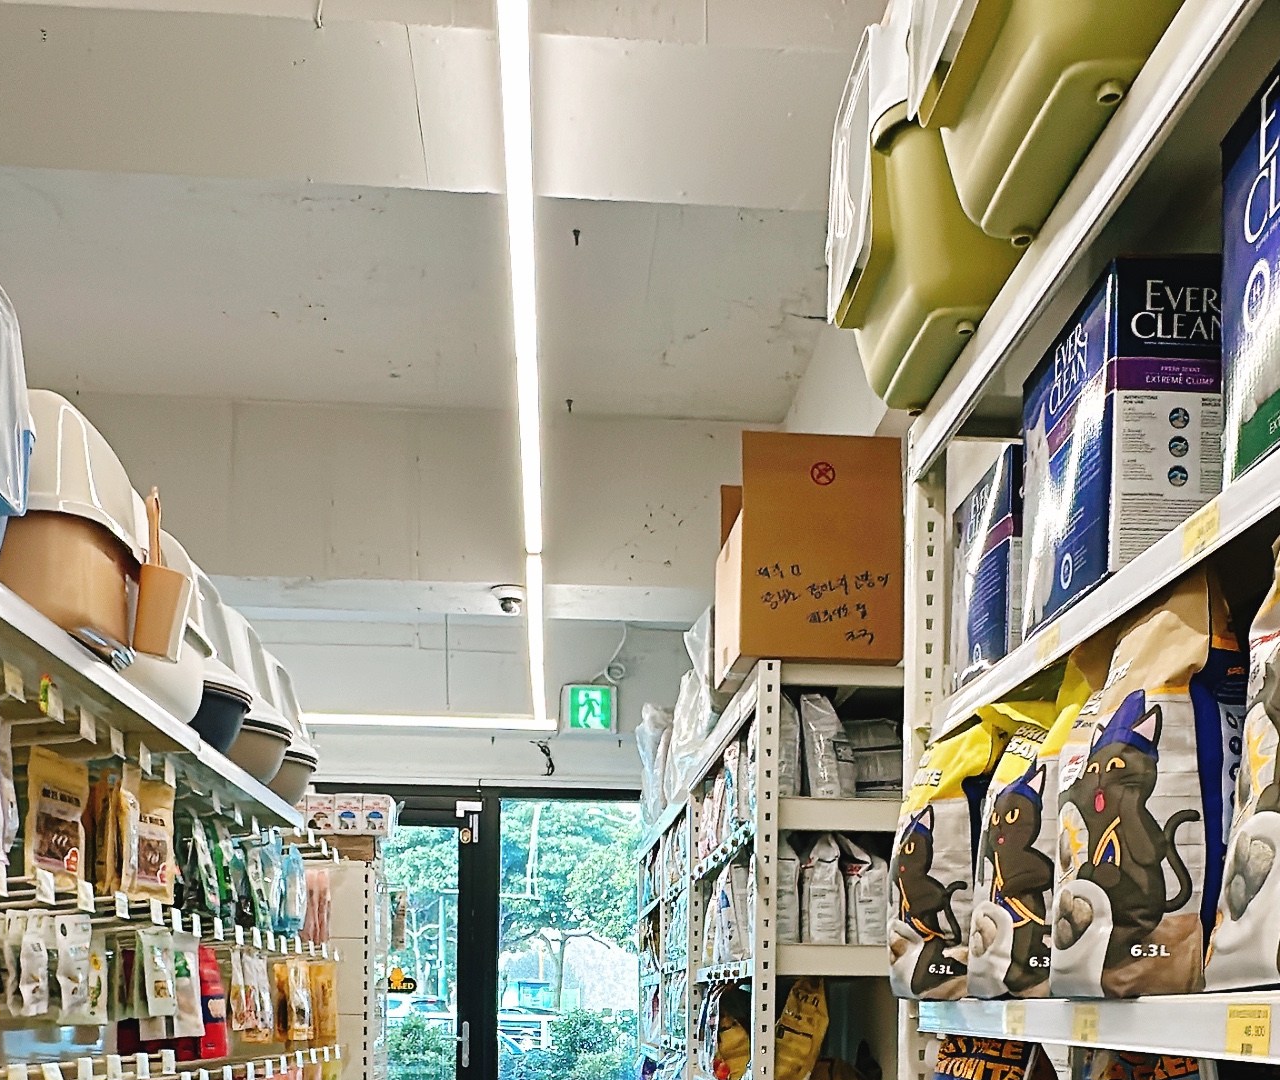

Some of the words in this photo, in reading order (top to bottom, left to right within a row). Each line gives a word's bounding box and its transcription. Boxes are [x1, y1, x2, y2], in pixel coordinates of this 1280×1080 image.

[1053, 322, 1088, 379] EVER
[1130, 943, 1171, 958] 6.3L
[928, 963, 954, 975] 6.3L
